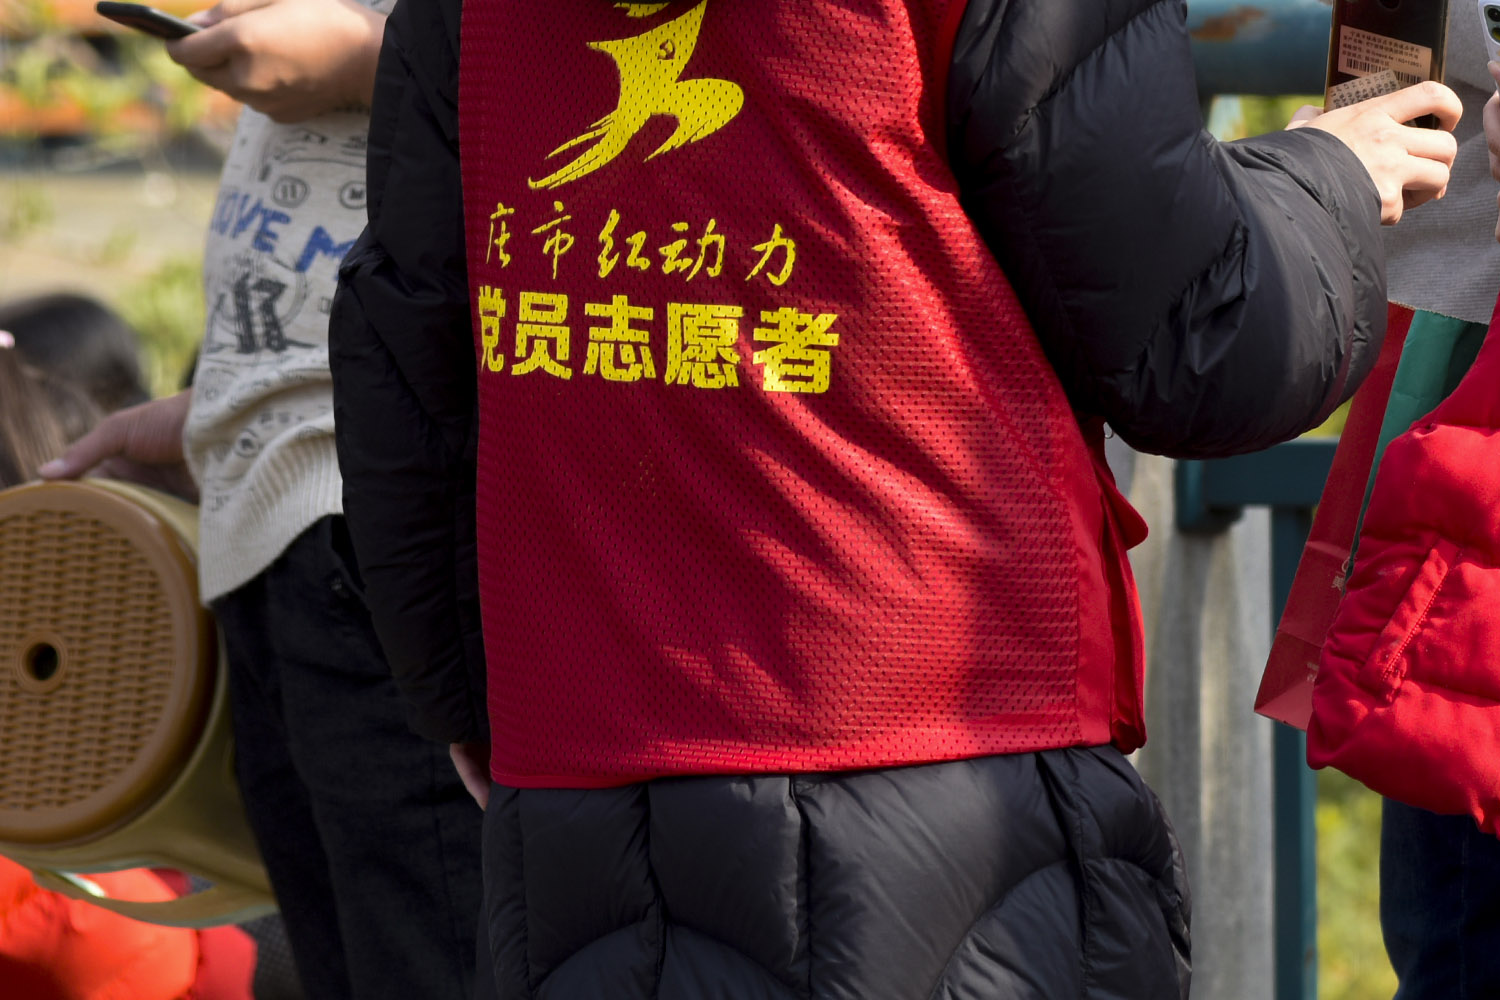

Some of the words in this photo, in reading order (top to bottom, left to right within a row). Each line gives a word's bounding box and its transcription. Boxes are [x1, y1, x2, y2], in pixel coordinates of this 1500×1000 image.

[478, 285, 840, 394] 党员志愿者
